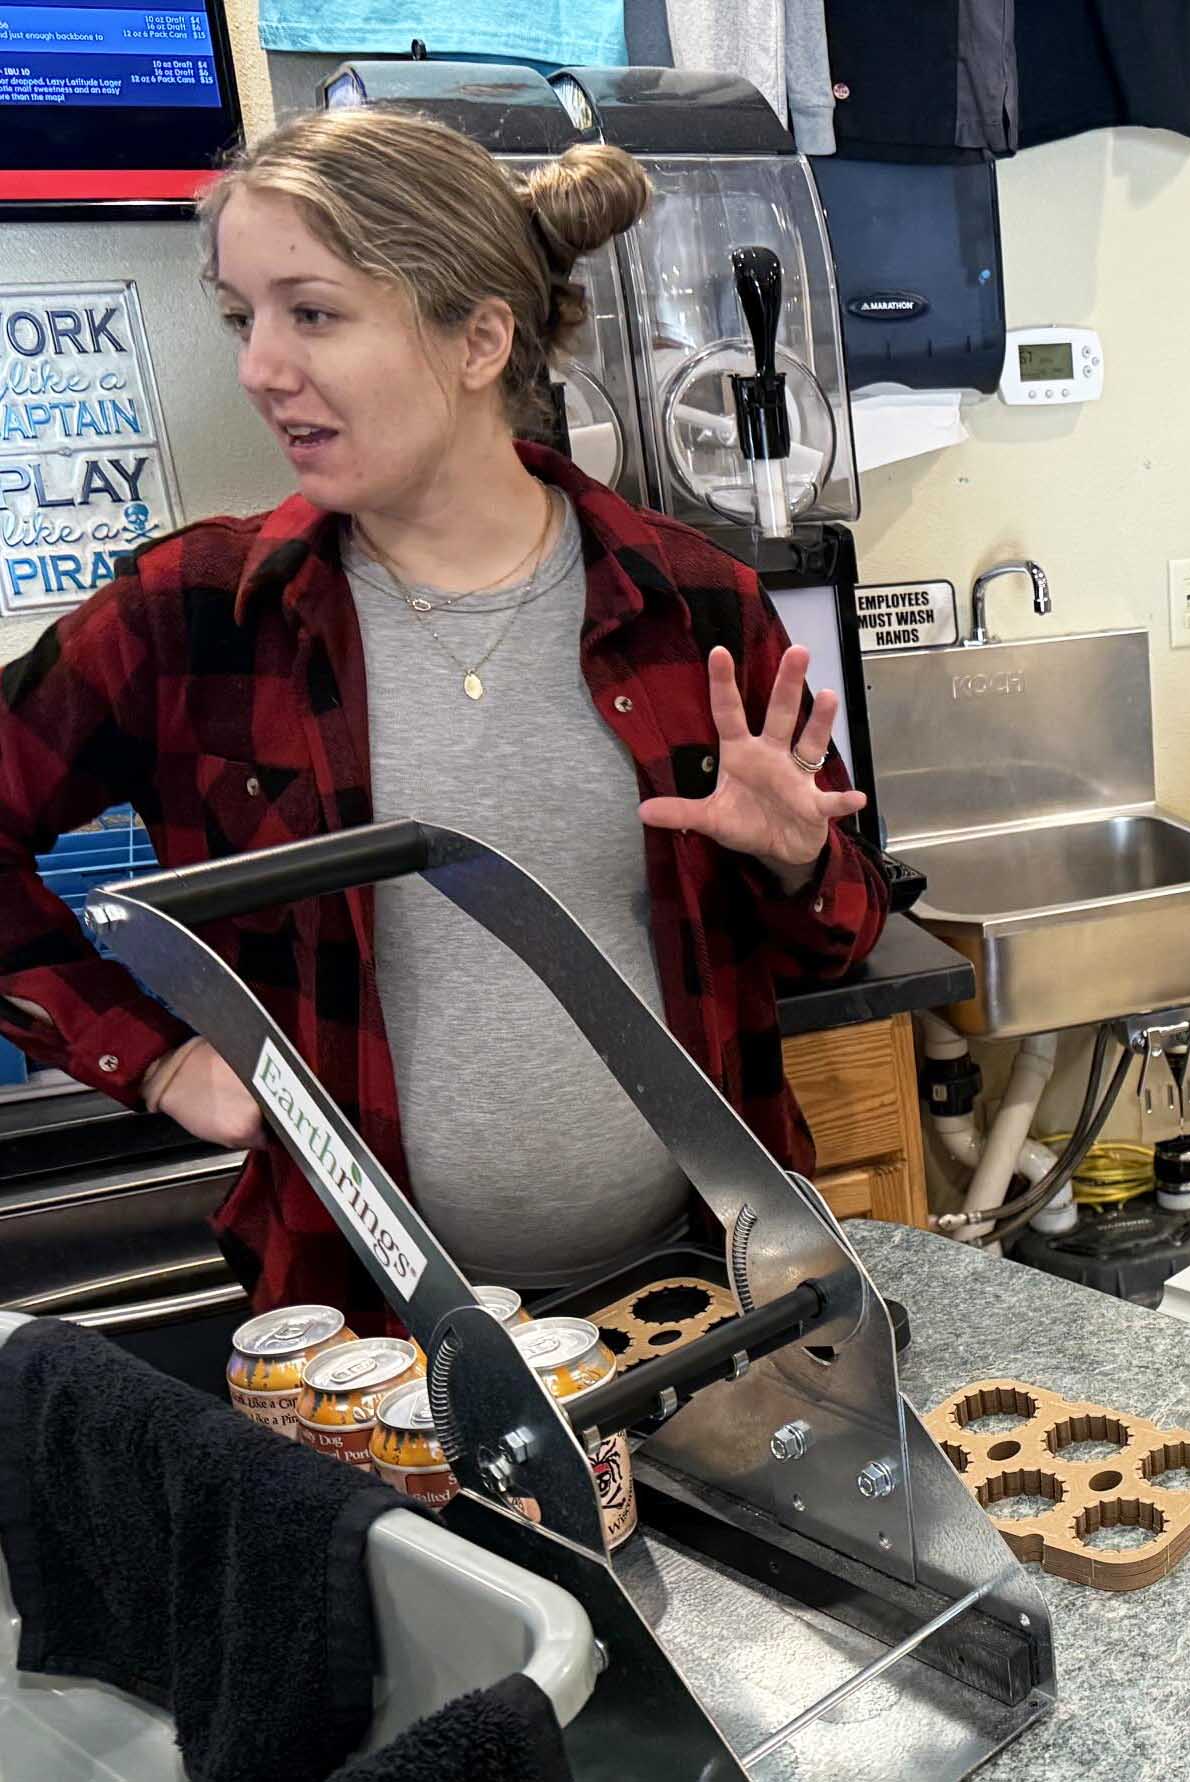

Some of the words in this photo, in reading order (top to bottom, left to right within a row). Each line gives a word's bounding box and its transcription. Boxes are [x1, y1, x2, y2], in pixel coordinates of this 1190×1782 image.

[9, 31, 24, 40] just
[25, 32, 55, 41] enough
[55, 32, 94, 41] backbone
[169, 31, 188, 39] Cans
[173, 60, 192, 68] Draft
[66, 78, 98, 86] Latitude
[100, 79, 122, 88] Lager
[102, 88, 120, 96] easy
[870, 301, 914, 310] MARATHON
[0, 308, 127, 357] ORK
[3, 359, 90, 395] like
[99, 372, 127, 391] a
[0, 399, 141, 440] APTAIN
[0, 457, 149, 510] PLAY
[1, 512, 85, 547] like
[92, 522, 120, 543] a
[6, 549, 137, 595] PIRA
[858, 591, 929, 611] EMPLOYEES
[857, 612, 893, 629] MUST
[895, 609, 935, 626] WASH
[876, 629, 919, 646] HANDS
[258, 1050, 412, 1279] Earthrings
[270, 1400, 276, 1409] a
[272, 1416, 279, 1425] a
[320, 1434, 343, 1448] Dog
[343, 1449, 370, 1462] Port
